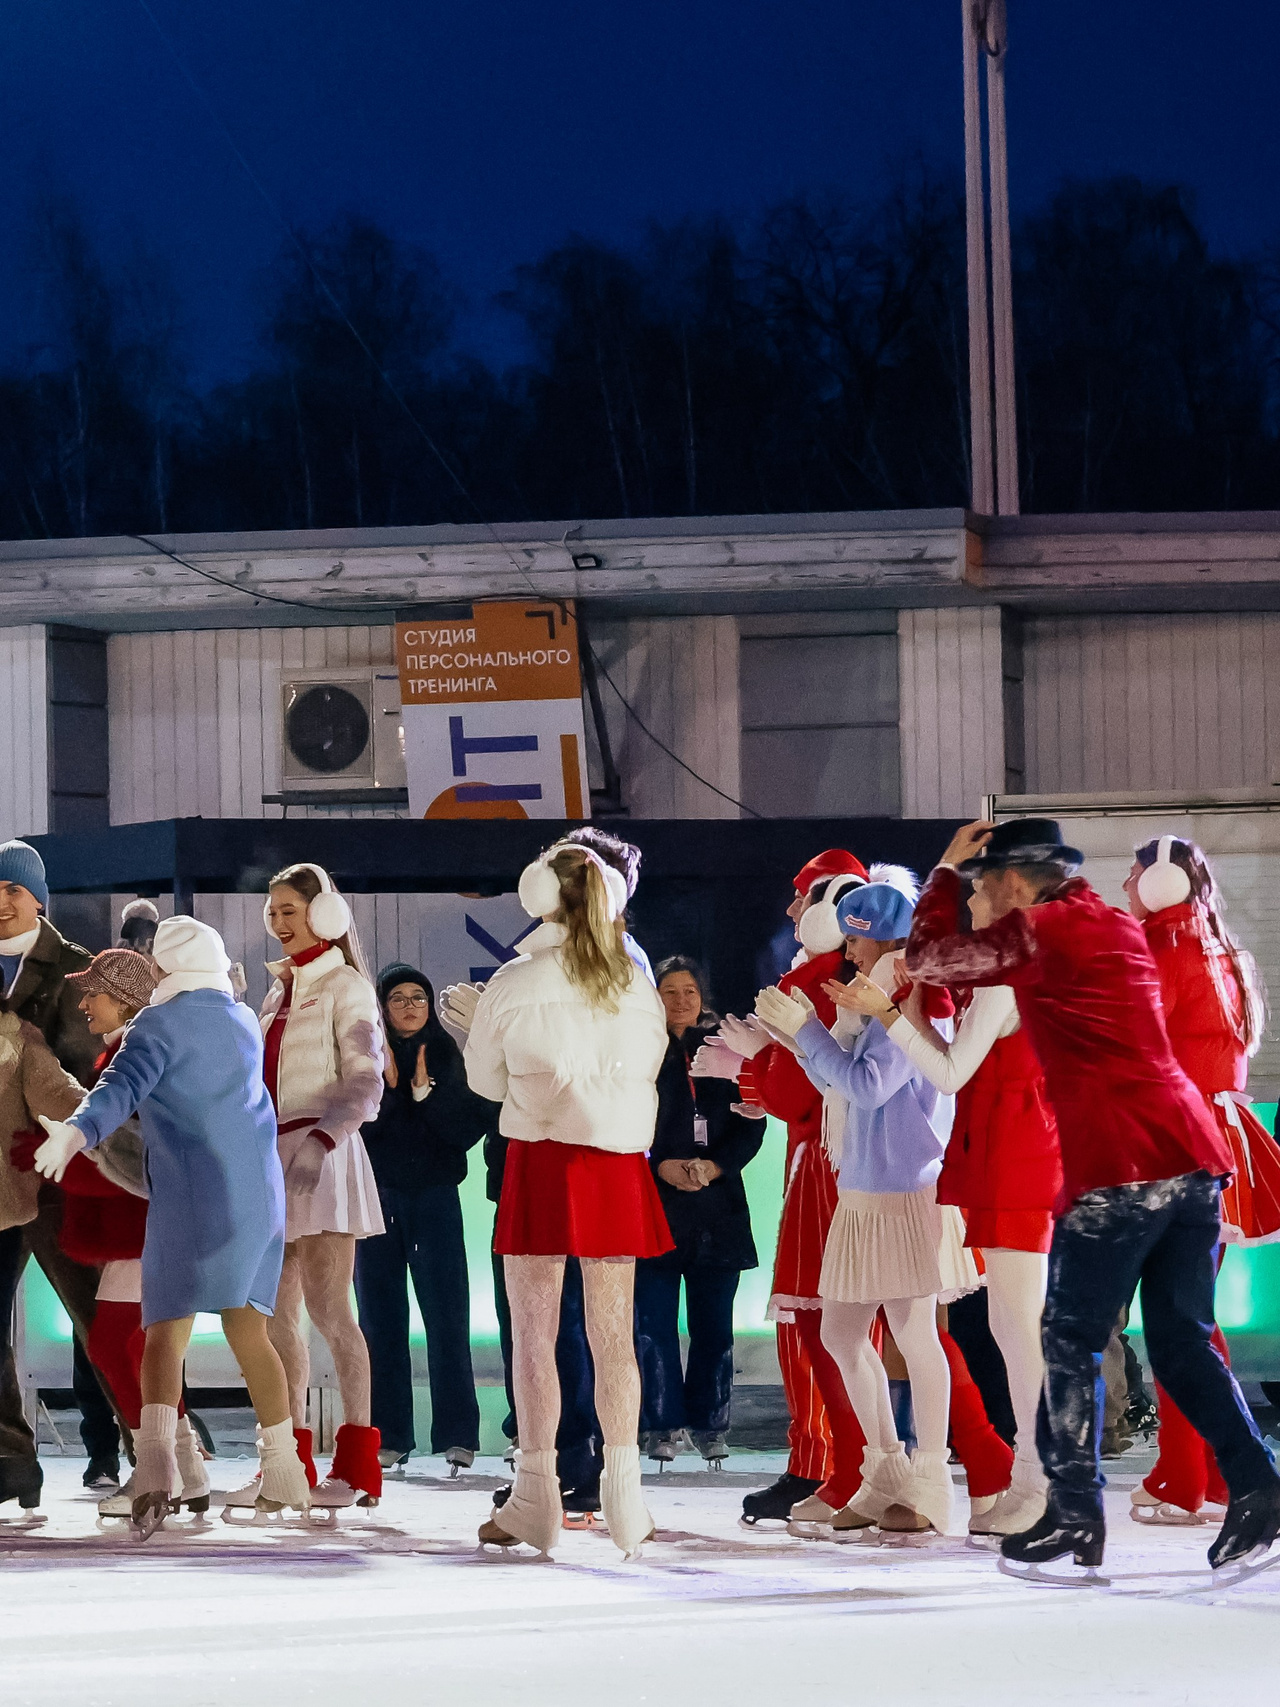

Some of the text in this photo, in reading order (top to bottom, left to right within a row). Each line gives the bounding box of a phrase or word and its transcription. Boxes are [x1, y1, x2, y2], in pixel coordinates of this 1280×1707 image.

[404, 628, 476, 648] СТУДИЯ
[406, 649, 571, 671] ПЕРСОНАЛЬНОГО
[408, 677, 498, 695] ТРЕНИНГА
